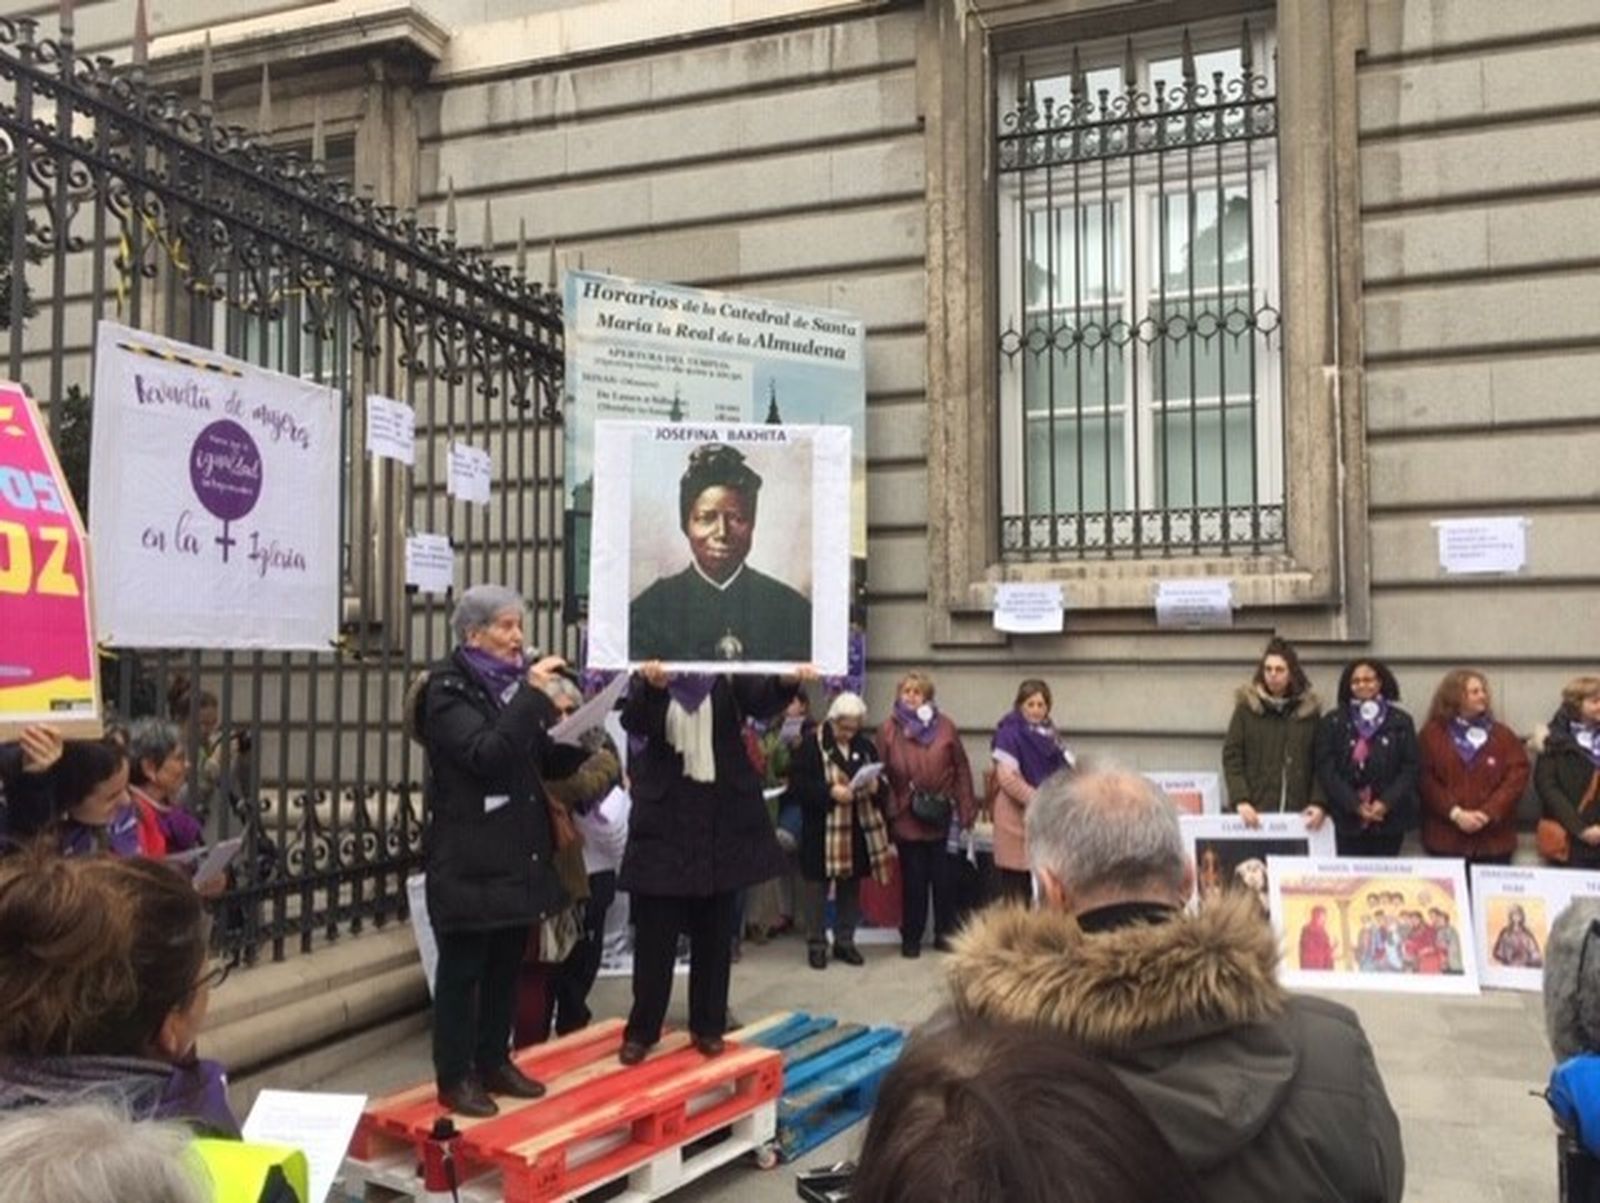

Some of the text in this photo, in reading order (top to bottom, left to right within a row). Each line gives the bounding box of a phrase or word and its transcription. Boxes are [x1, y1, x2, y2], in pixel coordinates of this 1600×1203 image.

[583, 281, 858, 337] Horarios de la Catedral de Santa
[596, 312, 847, 360] María la Real de la Almudena
[134, 373, 211, 410] Revuelta
[224, 388, 245, 418] de
[252, 404, 310, 450] mujeres
[655, 427, 787, 442] JOSEFINA BAKHITA
[141, 509, 307, 577] en la Iglesia
